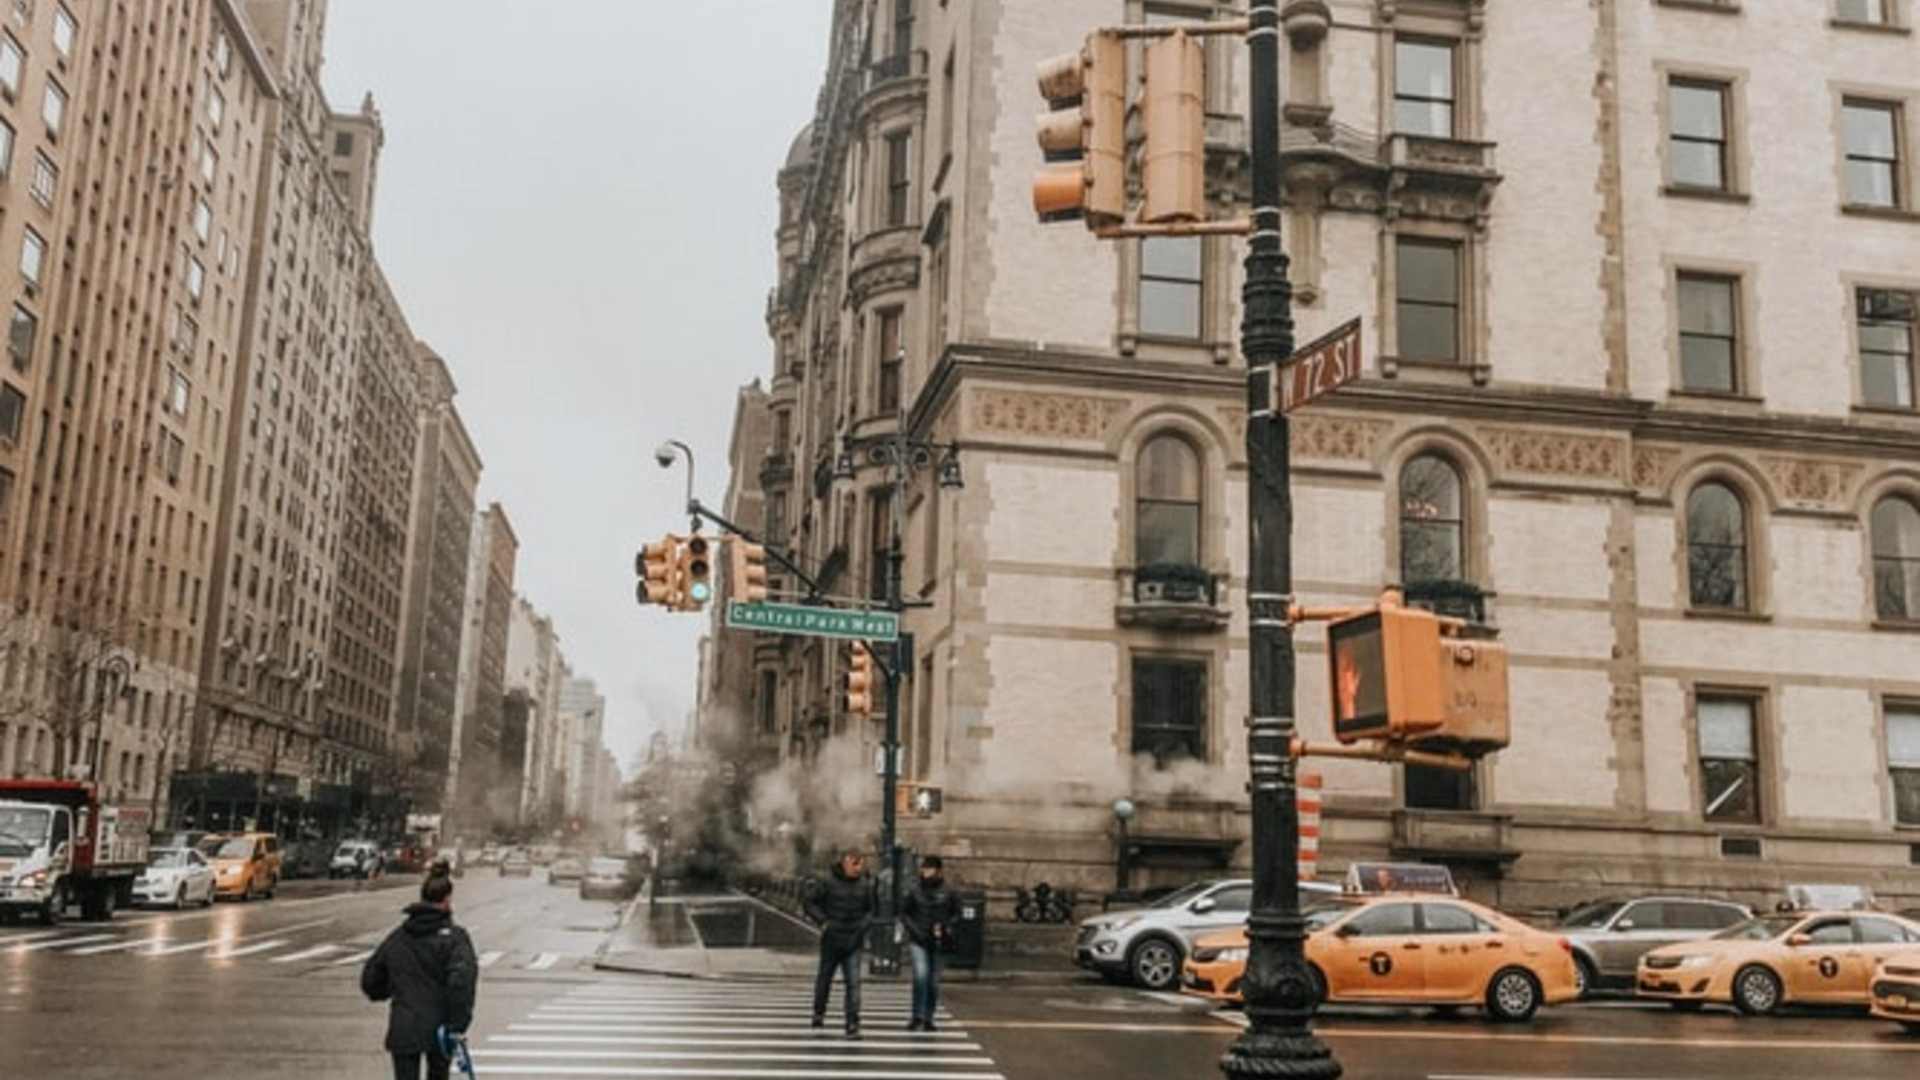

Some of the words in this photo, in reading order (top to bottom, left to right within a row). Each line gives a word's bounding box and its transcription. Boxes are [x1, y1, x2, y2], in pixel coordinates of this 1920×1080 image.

[1303, 351, 1325, 401] 72
[1333, 333, 1356, 384] ST
[733, 605, 801, 627] Central
[805, 613, 848, 630] Park
[851, 617, 895, 634] West
